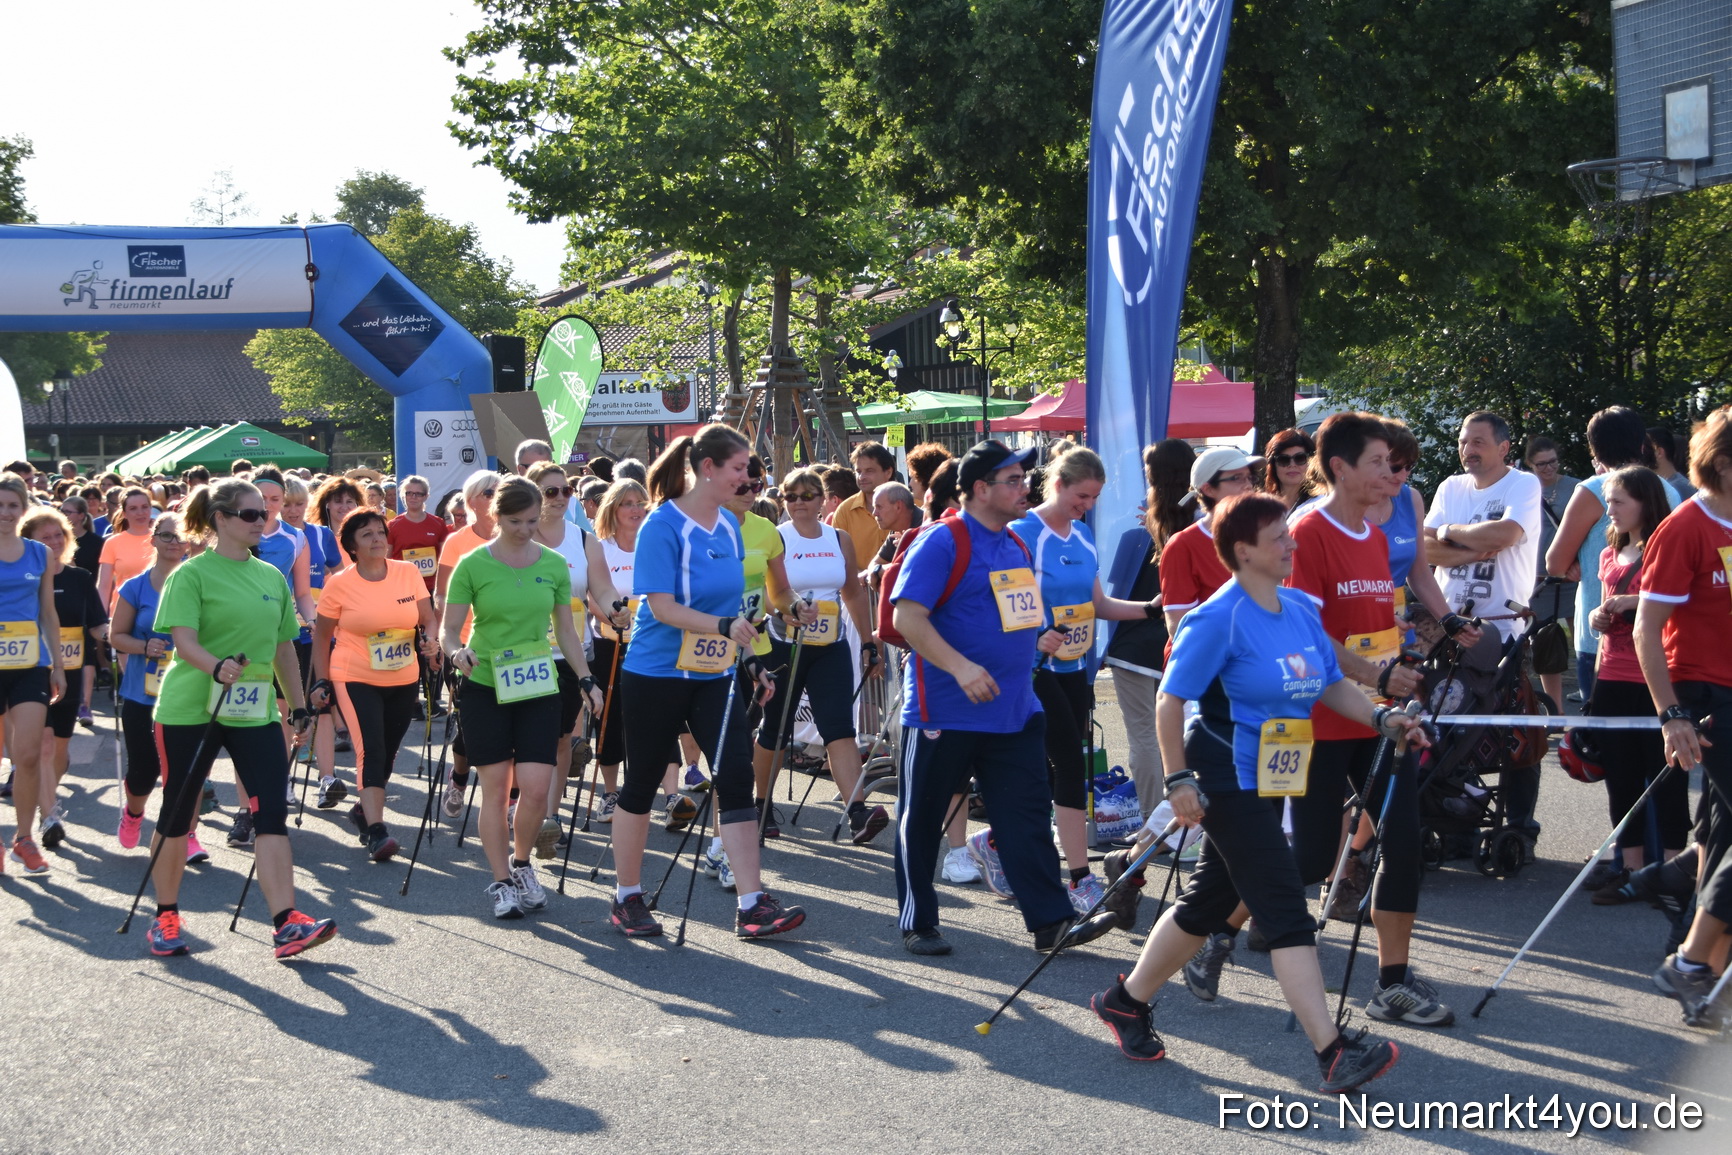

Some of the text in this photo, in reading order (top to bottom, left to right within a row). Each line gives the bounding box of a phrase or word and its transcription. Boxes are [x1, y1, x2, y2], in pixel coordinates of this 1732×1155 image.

[141, 258, 183, 266] Fischer
[110, 278, 235, 300] firmenlauf
[109, 301, 162, 309] neumarkt
[362, 318, 379, 327] und
[382, 316, 398, 324] das
[411, 324, 430, 332] mit!
[560, 371, 592, 409] AOK
[602, 402, 619, 411] grüßt
[397, 595, 416, 604] THULE
[1006, 591, 1037, 613] 732
[1064, 625, 1089, 646] 565
[374, 642, 411, 662] 1446
[694, 638, 728, 658] 563
[501, 662, 550, 687] 1545
[1283, 677, 1322, 692] camping
[1267, 750, 1301, 774] 493
